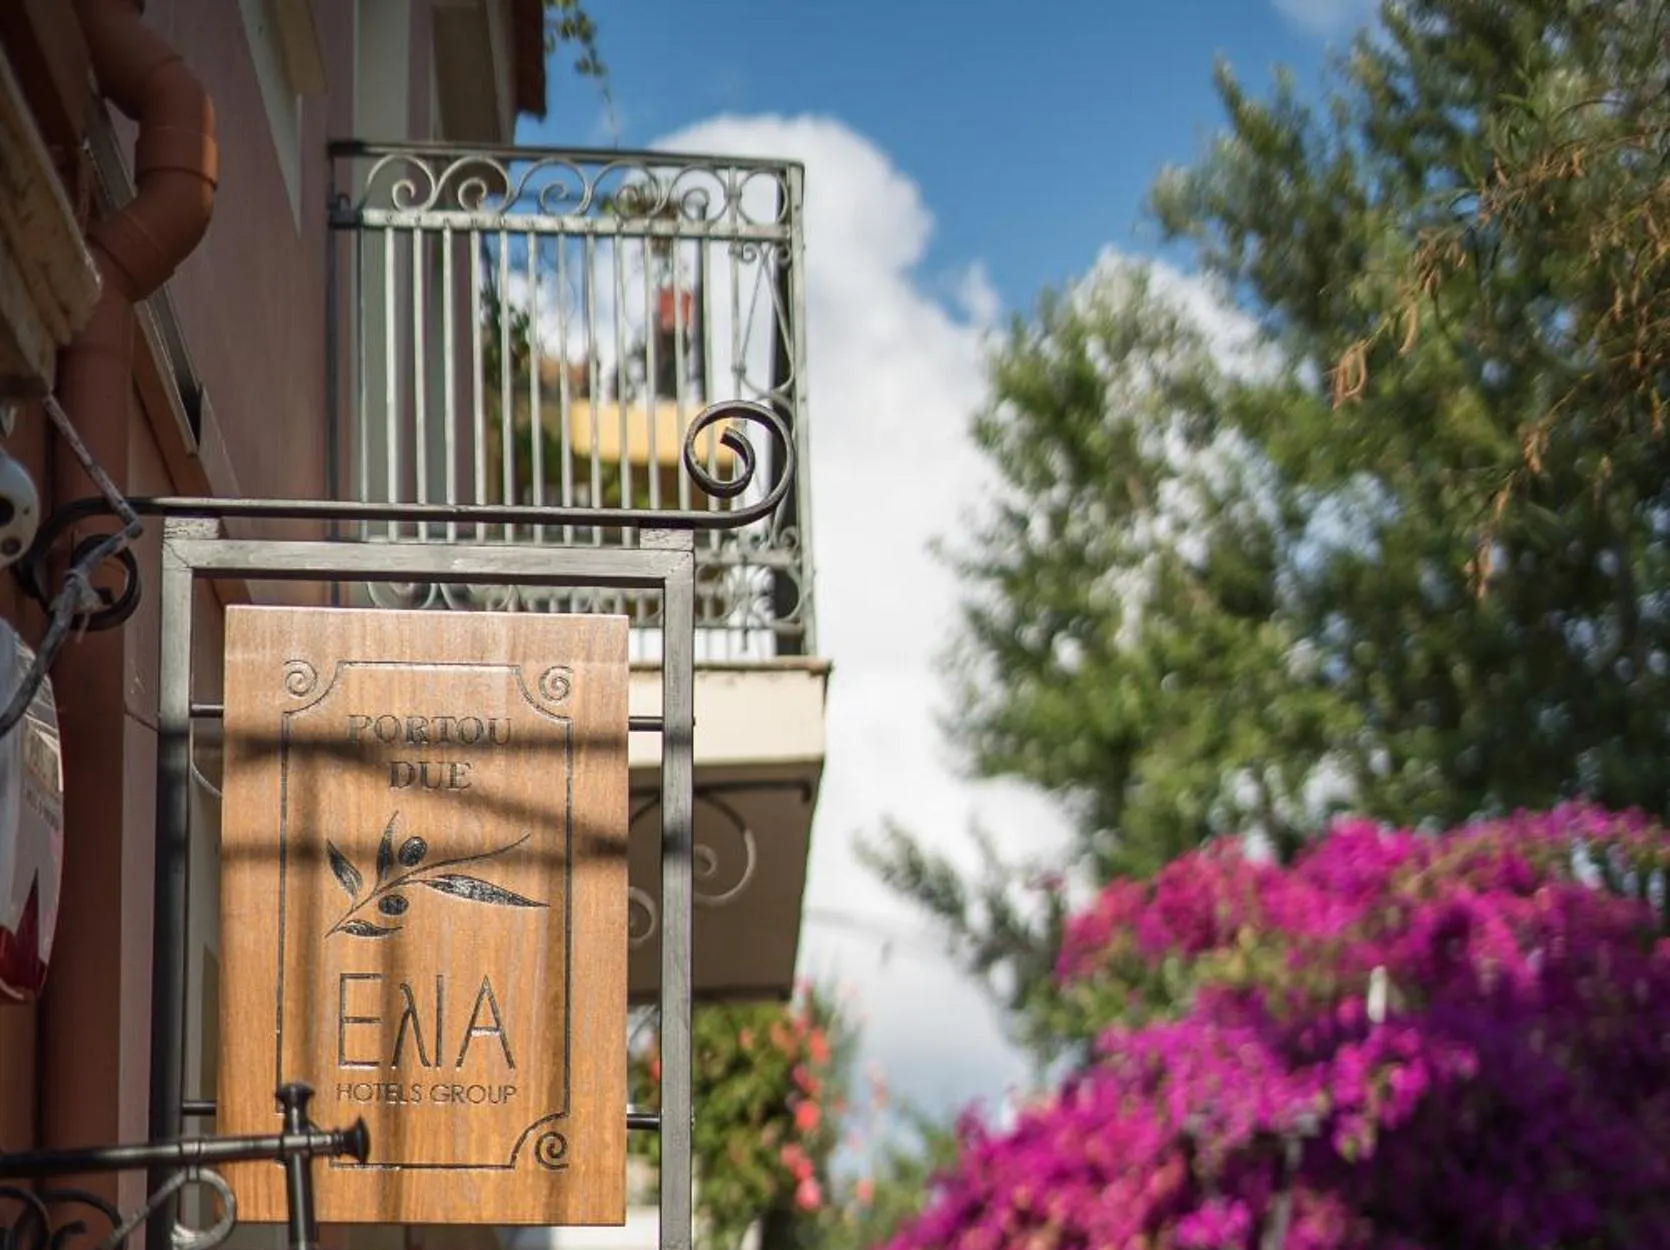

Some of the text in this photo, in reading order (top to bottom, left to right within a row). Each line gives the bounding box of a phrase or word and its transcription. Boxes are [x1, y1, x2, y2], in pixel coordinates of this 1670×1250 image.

[347, 714, 512, 747] PORTOU
[388, 760, 474, 790] DUE
[336, 1082, 518, 1105] HOTELS GROUP
